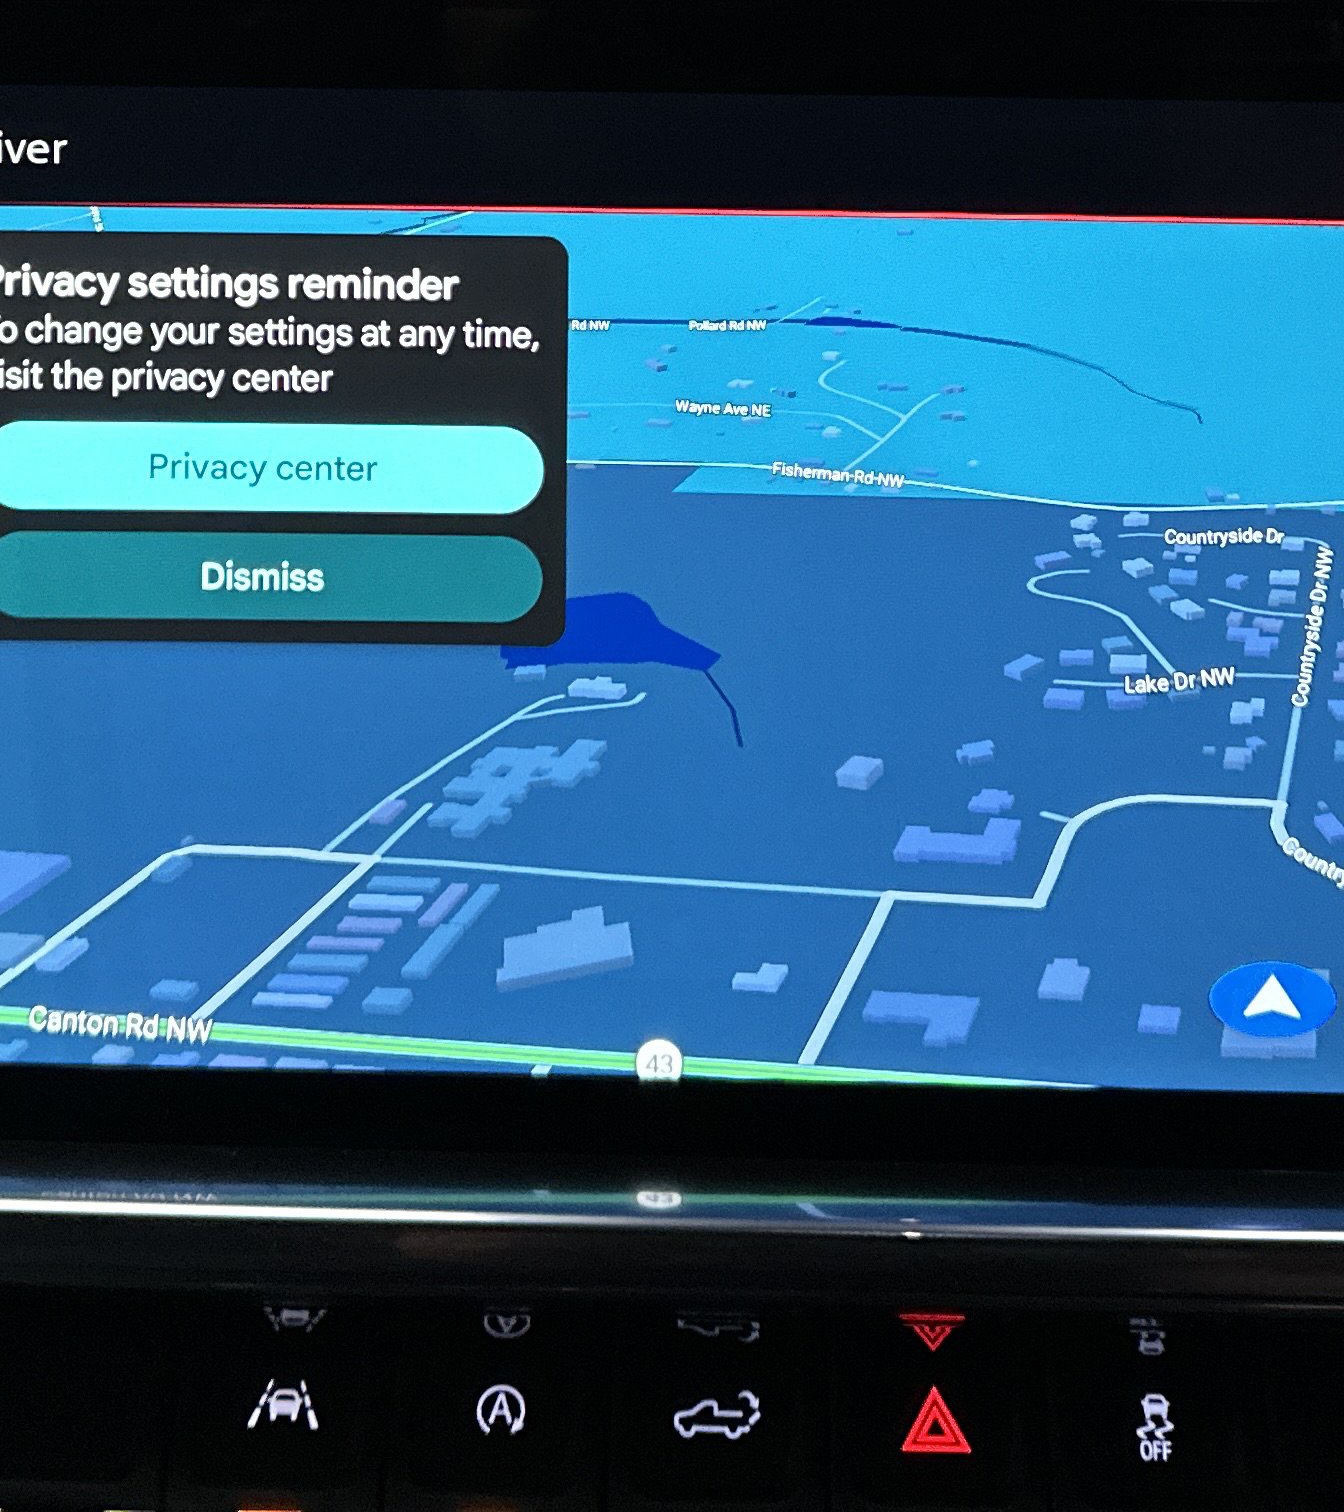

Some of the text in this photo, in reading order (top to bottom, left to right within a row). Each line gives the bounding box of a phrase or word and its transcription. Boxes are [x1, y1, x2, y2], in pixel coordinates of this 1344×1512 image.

[127, 264, 280, 308] settings
[288, 266, 461, 301] reminder
[24, 313, 143, 352] change
[150, 321, 221, 351] your
[228, 316, 354, 355] settings
[360, 320, 391, 347] at
[398, 324, 456, 355] any
[462, 317, 540, 353] time,
[571, 320, 611, 331] Rd NW
[688, 320, 767, 331] Pollard Rd NW
[50, 359, 104, 390] the
[111, 360, 226, 398] privacy
[232, 364, 334, 392] center
[675, 399, 772, 418] Wayne Ave NE
[149, 451, 378, 488] Privacy center
[771, 461, 905, 488] Fisherman Rd NW
[1164, 527, 1285, 548] Countryside Dr
[200, 558, 326, 592] Dismiss
[1291, 545, 1335, 708] Countryside Dr NW
[1124, 666, 1235, 695] Lake Dr NW
[28, 1004, 214, 1048] Canton Rd NW
[645, 1053, 674, 1074] 43
[1139, 1439, 1174, 1463] OFF
